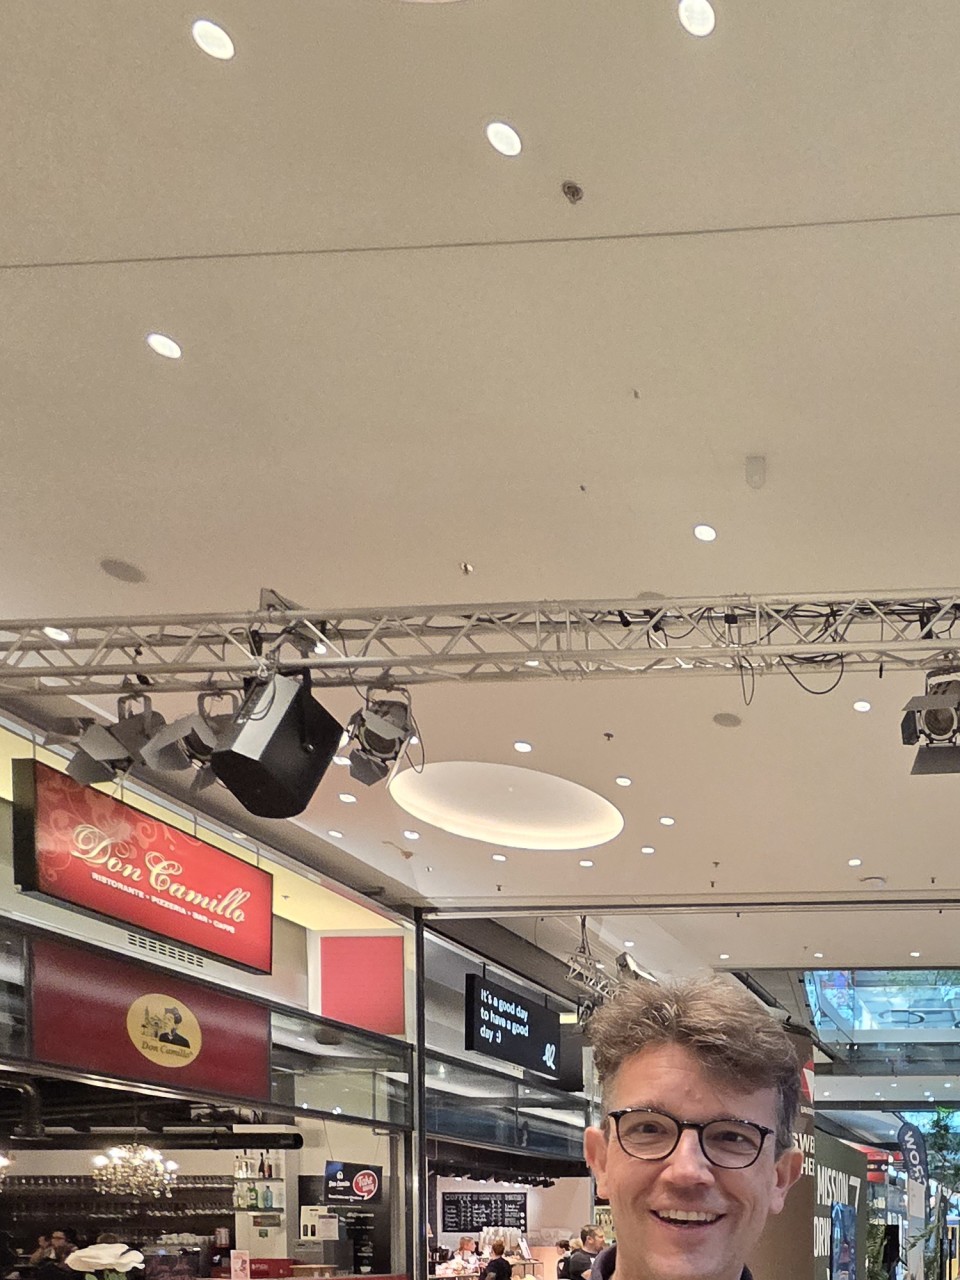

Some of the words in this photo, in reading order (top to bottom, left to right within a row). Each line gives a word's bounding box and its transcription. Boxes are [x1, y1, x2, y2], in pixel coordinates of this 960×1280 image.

[71, 824, 143, 881] Don
[145, 851, 250, 923] Camillo
[91, 872, 145, 899] RISTORANTE
[480, 988, 492, 1005] It's
[493, 996, 498, 1007] a
[499, 999, 516, 1015] good
[516, 1005, 528, 1023] day
[480, 1006, 489, 1020] to
[490, 1010, 506, 1028] have
[506, 1019, 511, 1030] a
[512, 1022, 529, 1037] good
[480, 1024, 493, 1043] day
[141, 1041, 159, 1053] Don
[817, 1164, 849, 1206] MISSION
